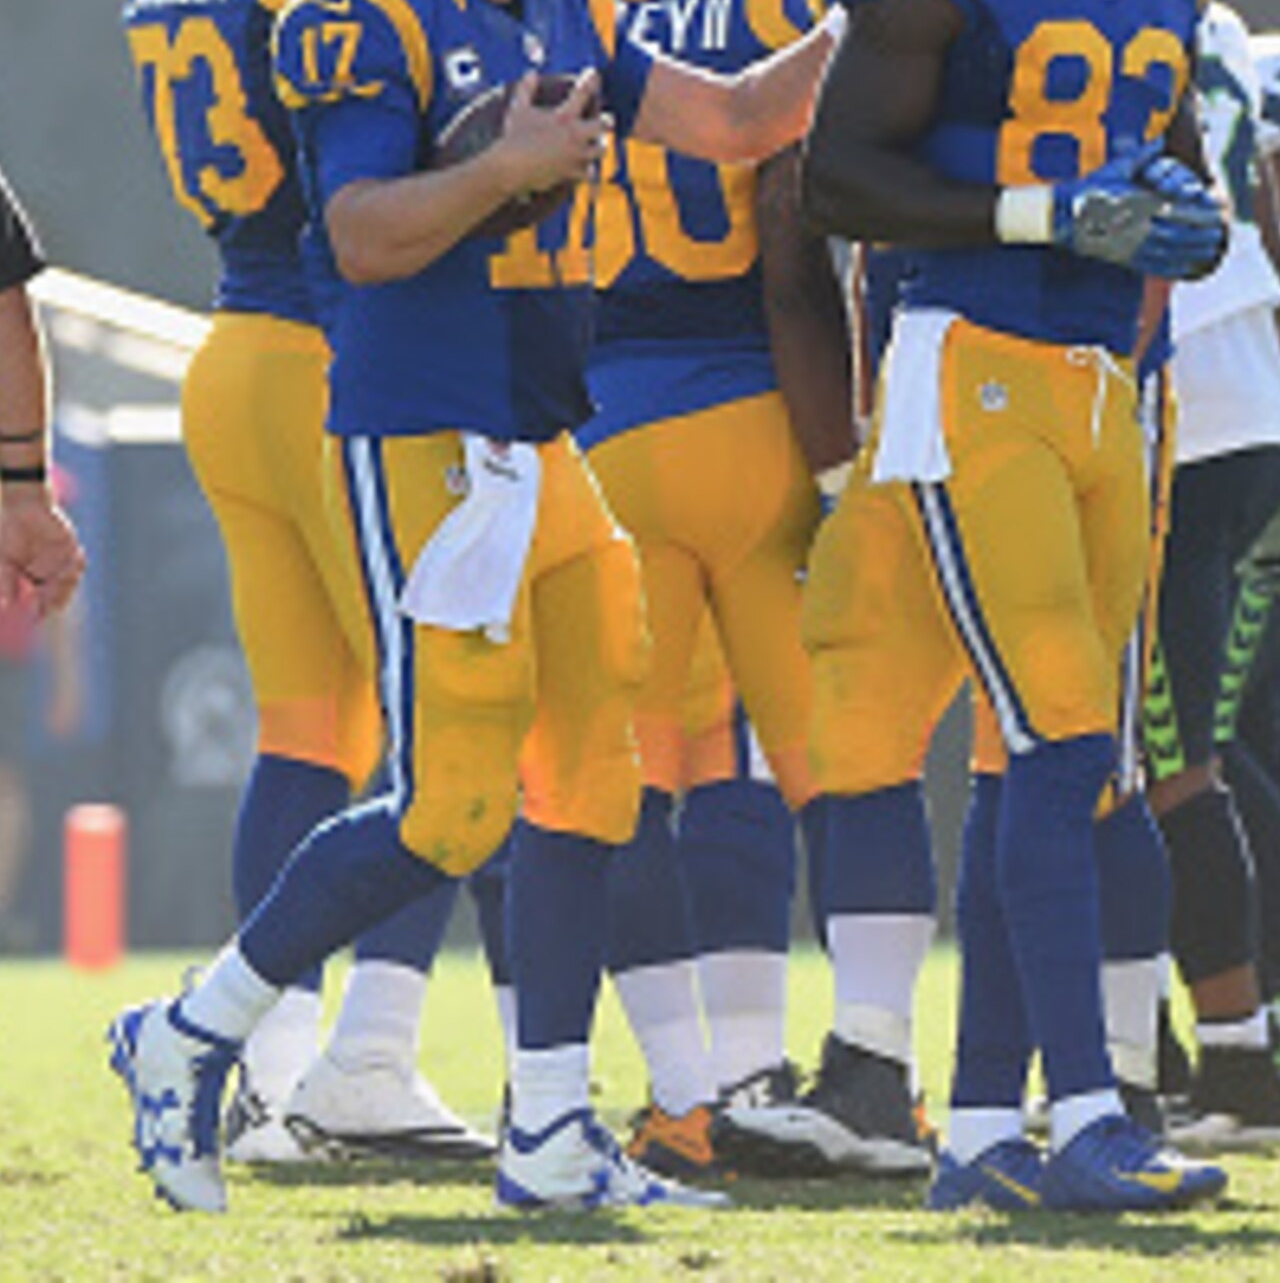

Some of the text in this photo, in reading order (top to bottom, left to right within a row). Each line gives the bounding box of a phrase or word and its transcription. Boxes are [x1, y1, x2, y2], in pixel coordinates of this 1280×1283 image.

[302, 22, 363, 88] 17
[445, 49, 481, 90] C
[126, 17, 286, 229] 73
